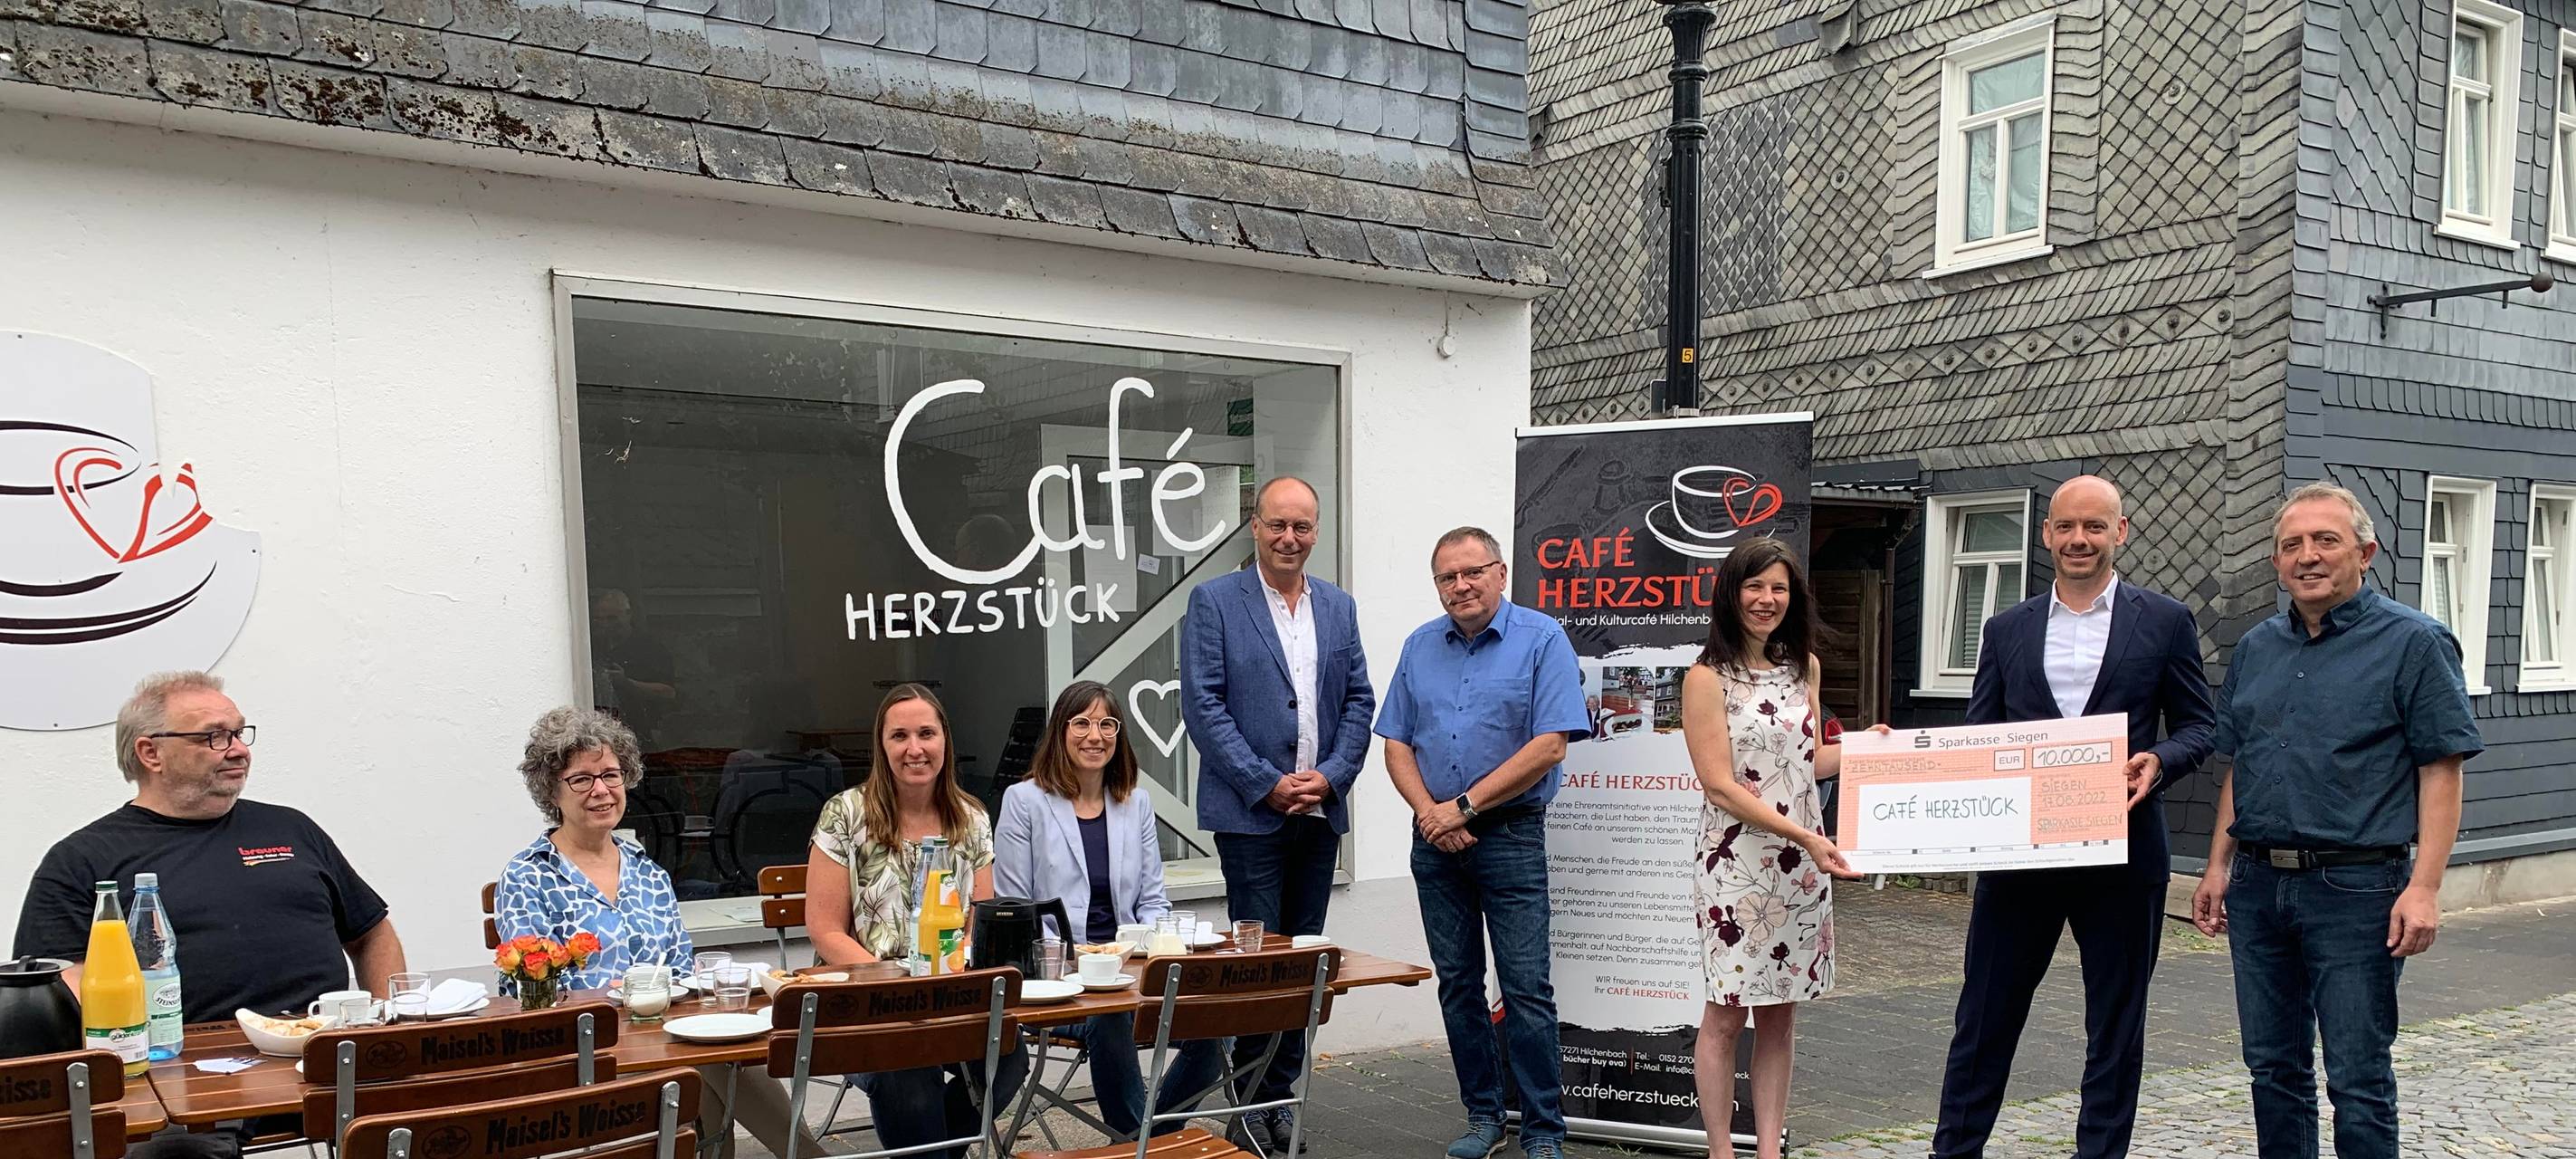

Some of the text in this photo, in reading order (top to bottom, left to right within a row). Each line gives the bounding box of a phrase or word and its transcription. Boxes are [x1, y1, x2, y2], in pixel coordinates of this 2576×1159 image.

[1684, 350, 1692, 361] 5
[884, 377, 1226, 584] Café
[1538, 527, 1635, 569] CAFÉ
[1538, 566, 1717, 609] HERZSTÜ
[845, 577, 1121, 641] HERZSTÜCK
[1575, 615, 1597, 626] und
[1599, 614, 1657, 626] Kulturcafé
[1660, 613, 1712, 625] Hilchenb
[1938, 735, 2000, 750] Sparkasse
[2008, 731, 2048, 745] Siegen
[1999, 755, 2020, 765] EUR
[1606, 773, 1703, 791] HERZSTÜC
[1575, 801, 1651, 811] Ehrenamtsinitiative
[1670, 804, 1703, 813] Hilchen
[1874, 795, 2018, 820] CAFÉ HERZSTÜCK
[1606, 813, 1621, 821] Lust
[1672, 816, 1699, 824] Traum
[1547, 822, 1571, 830] feinen
[1573, 822, 1592, 830] Café
[1645, 825, 1678, 834] schönen
[1681, 827, 1697, 835] Mar
[1612, 836, 1642, 844] werden
[1598, 856, 1609, 864] die
[1612, 857, 1639, 866] Freude
[1655, 858, 1671, 867] den
[1586, 867, 1608, 876] gerne
[1627, 869, 1660, 877] anderen
[1550, 886, 1565, 895] sind
[1568, 887, 1616, 897] Freundinnen
[1618, 890, 1634, 898] und
[1636, 891, 1670, 900] Freunde
[1562, 898, 1595, 907] gehören
[1609, 901, 1642, 909] unseren
[1644, 902, 1695, 911] Lebensmitte
[1570, 909, 1595, 917] Neues
[1598, 910, 1613, 918] und
[1615, 911, 1650, 921] möchten
[1665, 914, 1694, 923] Neuem
[1557, 929, 1605, 940] Bürgerinnen
[1608, 933, 1623, 941] und
[1656, 935, 1669, 943] die
[1671, 935, 1685, 944] auf
[1590, 942, 1605, 950] auf
[1607, 943, 1688, 955] Nachbarschaftshilfe
[1556, 952, 1584, 960] Kleinen
[1617, 955, 1638, 963] Denn
[1640, 958, 1686, 966] zusammen
[1218, 960, 1311, 988] Maisel's Weisse
[1596, 975, 1611, 983] WIR
[1613, 976, 1639, 986] freuen
[1658, 980, 1673, 988] auf
[1674, 981, 1689, 989] SIE!
[1607, 986, 1630, 996] CAFÉ
[1633, 988, 1689, 1000] HERZSTÜCK
[420, 1025, 566, 1066] Maisel's Weisse
[1563, 1053, 1589, 1063] bücher
[1592, 1058, 1607, 1067] buy
[1608, 1059, 1627, 1068] eva)
[1580, 1048, 1627, 1058] Hilchenbach
[1659, 1054, 1676, 1062] 0152
[0, 1076, 52, 1104] isse
[485, 1098, 647, 1155] Maisel's Weisse
